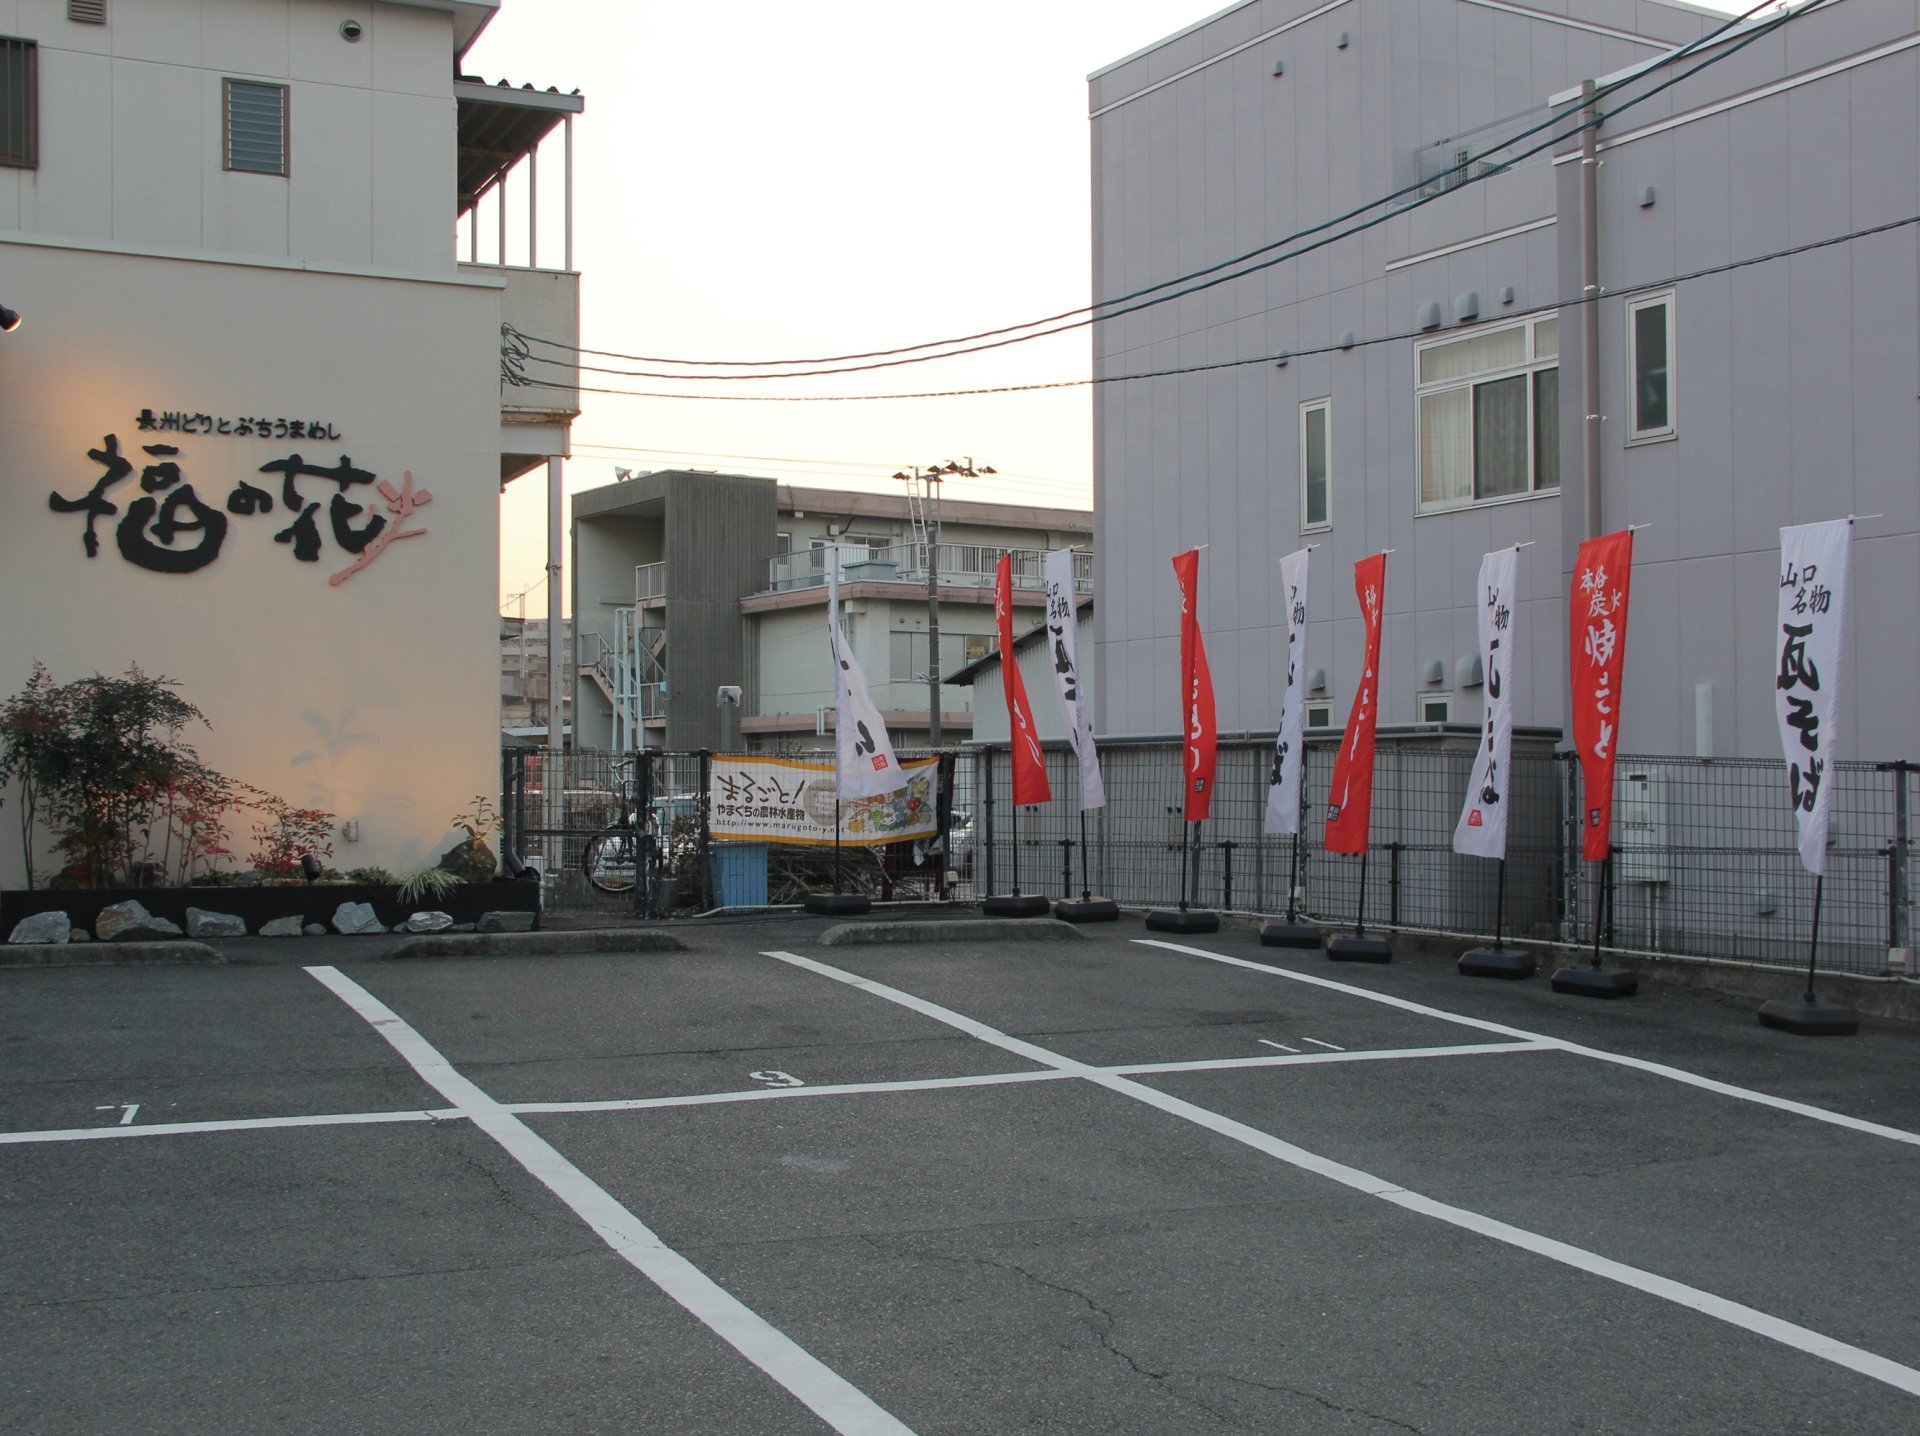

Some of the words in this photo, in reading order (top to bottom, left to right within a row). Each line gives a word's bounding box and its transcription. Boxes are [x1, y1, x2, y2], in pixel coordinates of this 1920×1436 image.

[135, 409, 342, 441] 長州どりとぶちうまめし
[49, 433, 386, 574] 福の花
[1777, 623, 1823, 812] 瓦そば
[716, 818, 845, 834] http://www.marugoto-y.nt
